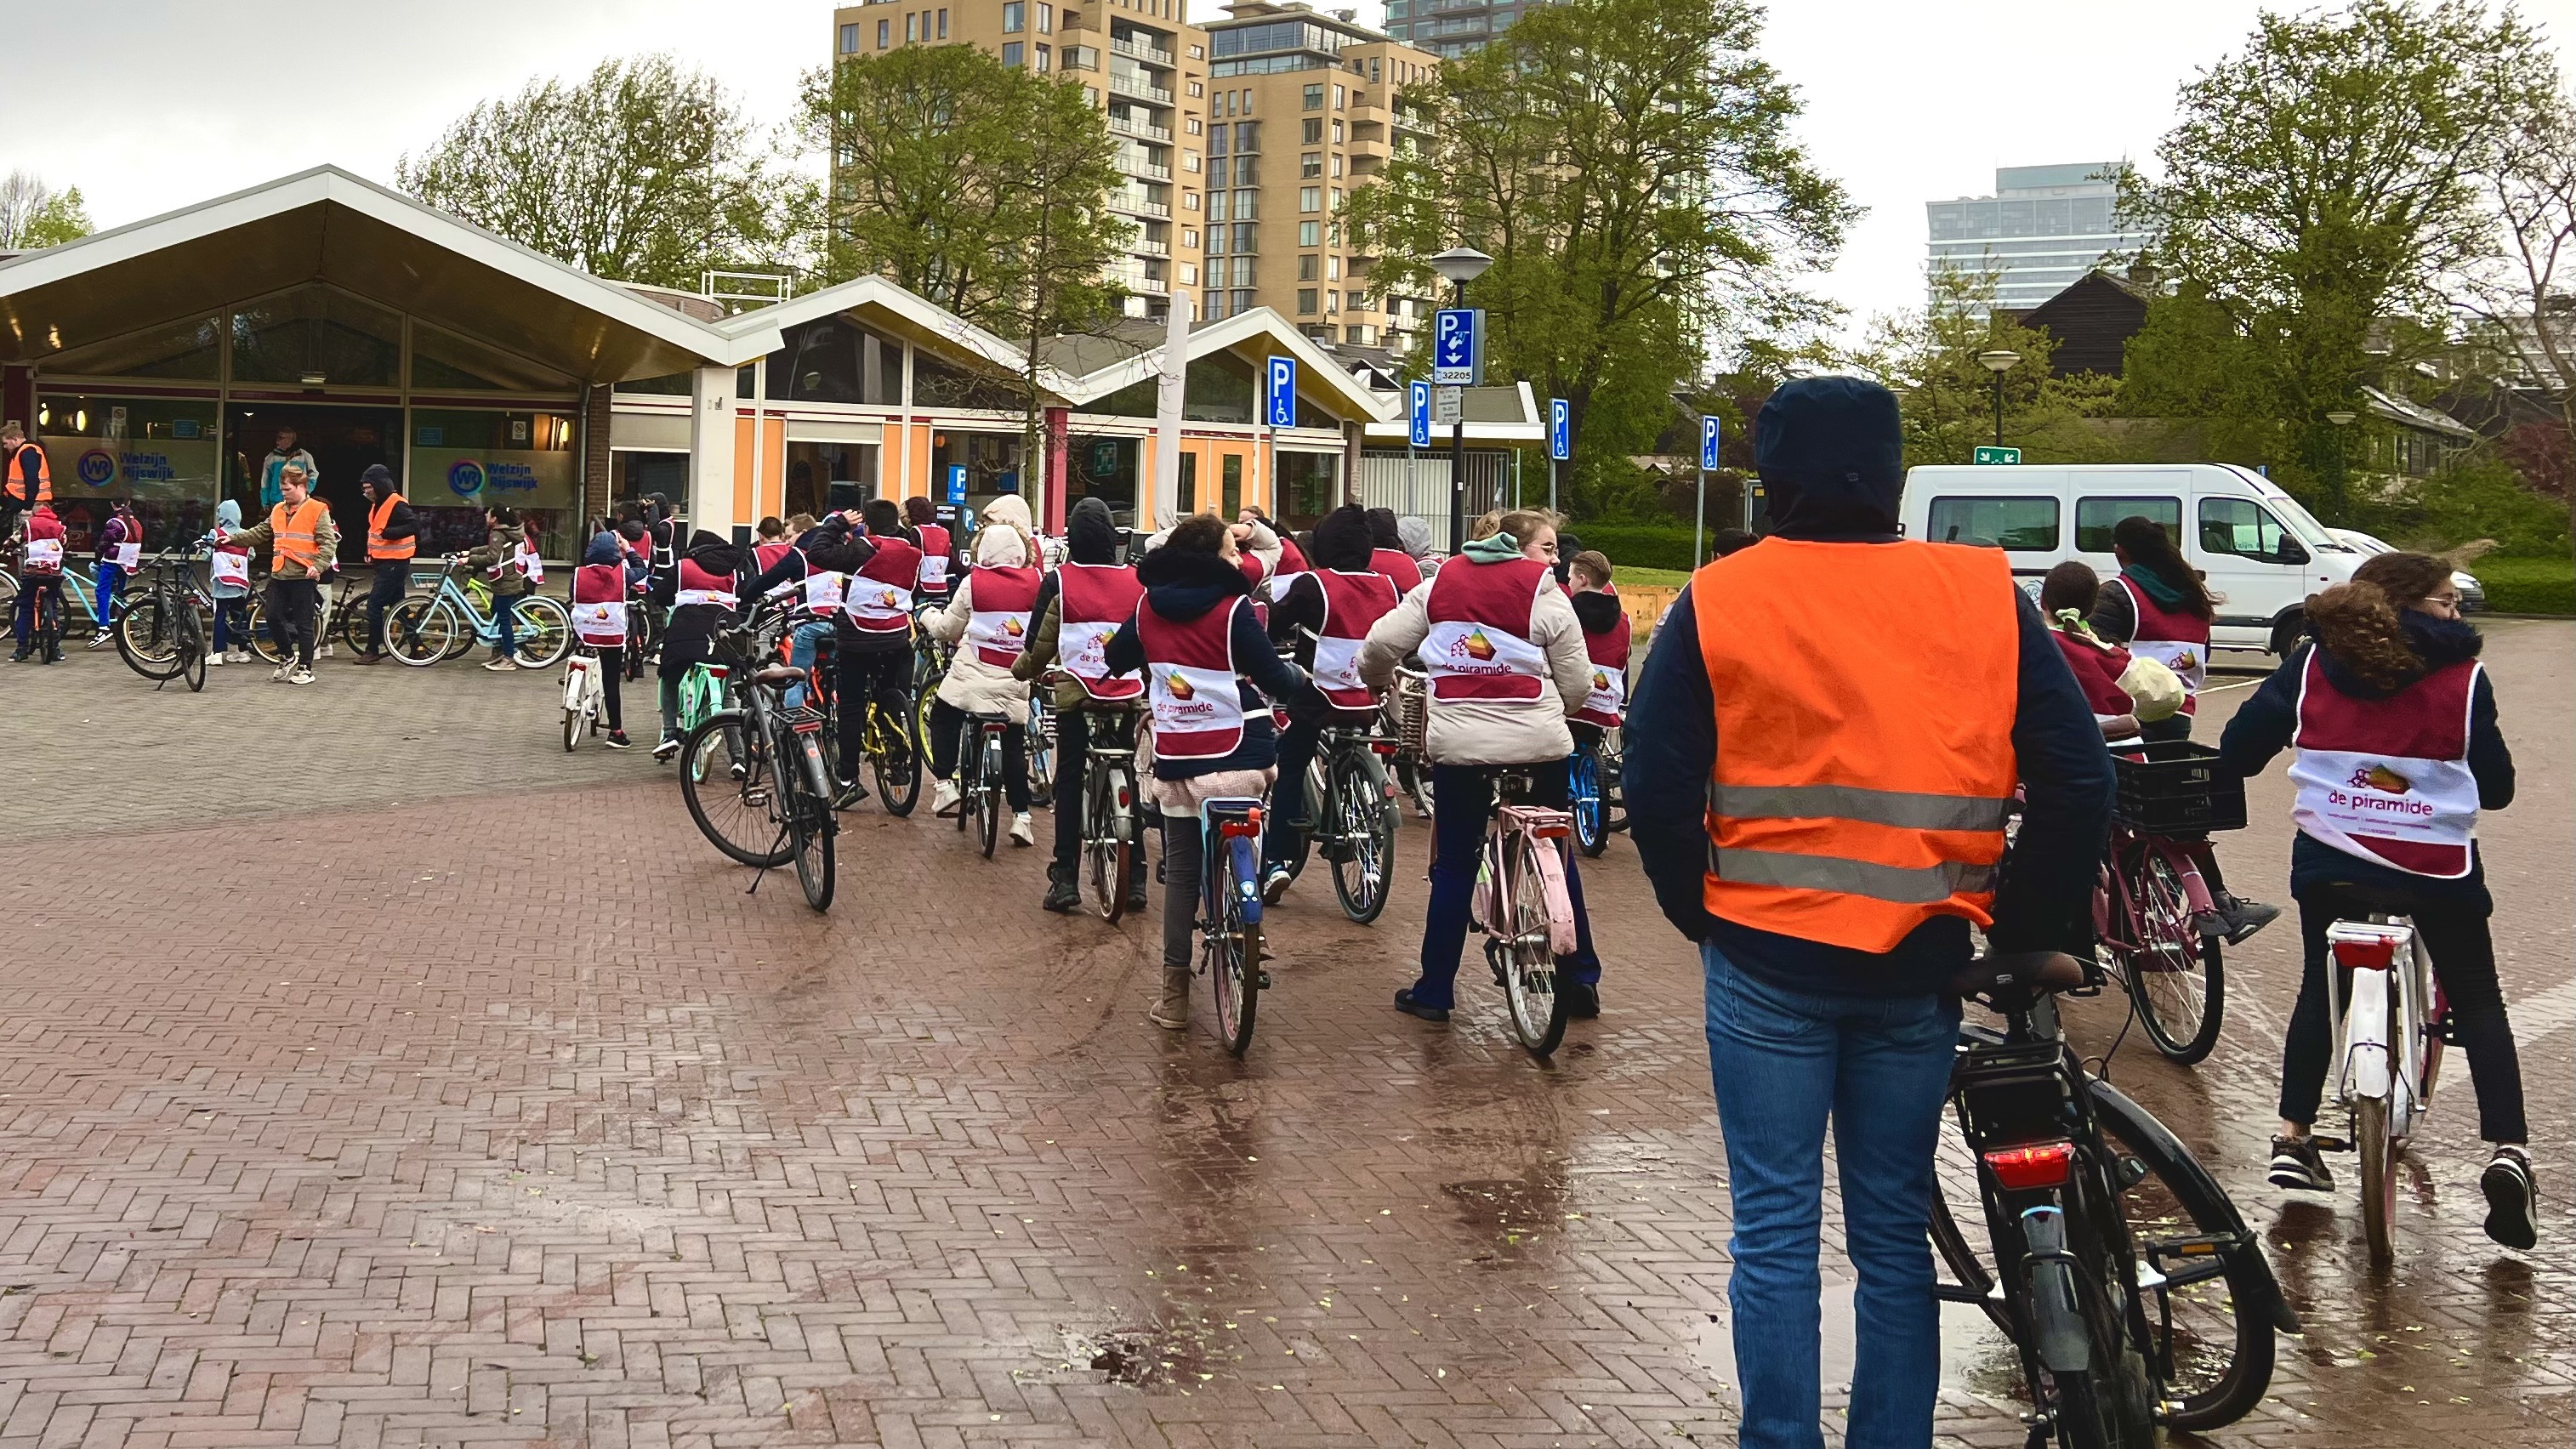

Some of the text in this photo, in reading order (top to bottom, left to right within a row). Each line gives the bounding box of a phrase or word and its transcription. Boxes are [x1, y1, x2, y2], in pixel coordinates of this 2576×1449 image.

[1441, 315, 1458, 340] P
[1274, 362, 1289, 397] P
[1414, 386, 1425, 418] P
[1555, 404, 1565, 434] P
[1706, 420, 1715, 446] P
[119, 452, 167, 467] Welzijn
[85, 460, 109, 476] WR
[122, 466, 174, 481] Rijswijk
[486, 463, 531, 476] Welzijn
[455, 470, 479, 485] WR
[490, 476, 537, 491] Rijswijk
[957, 469, 965, 488] P
[965, 510, 973, 527] P
[1079, 652, 1091, 662] de
[1340, 670, 1352, 679] de
[1458, 662, 1512, 674] piramide
[2329, 789, 2434, 816] de piramide
